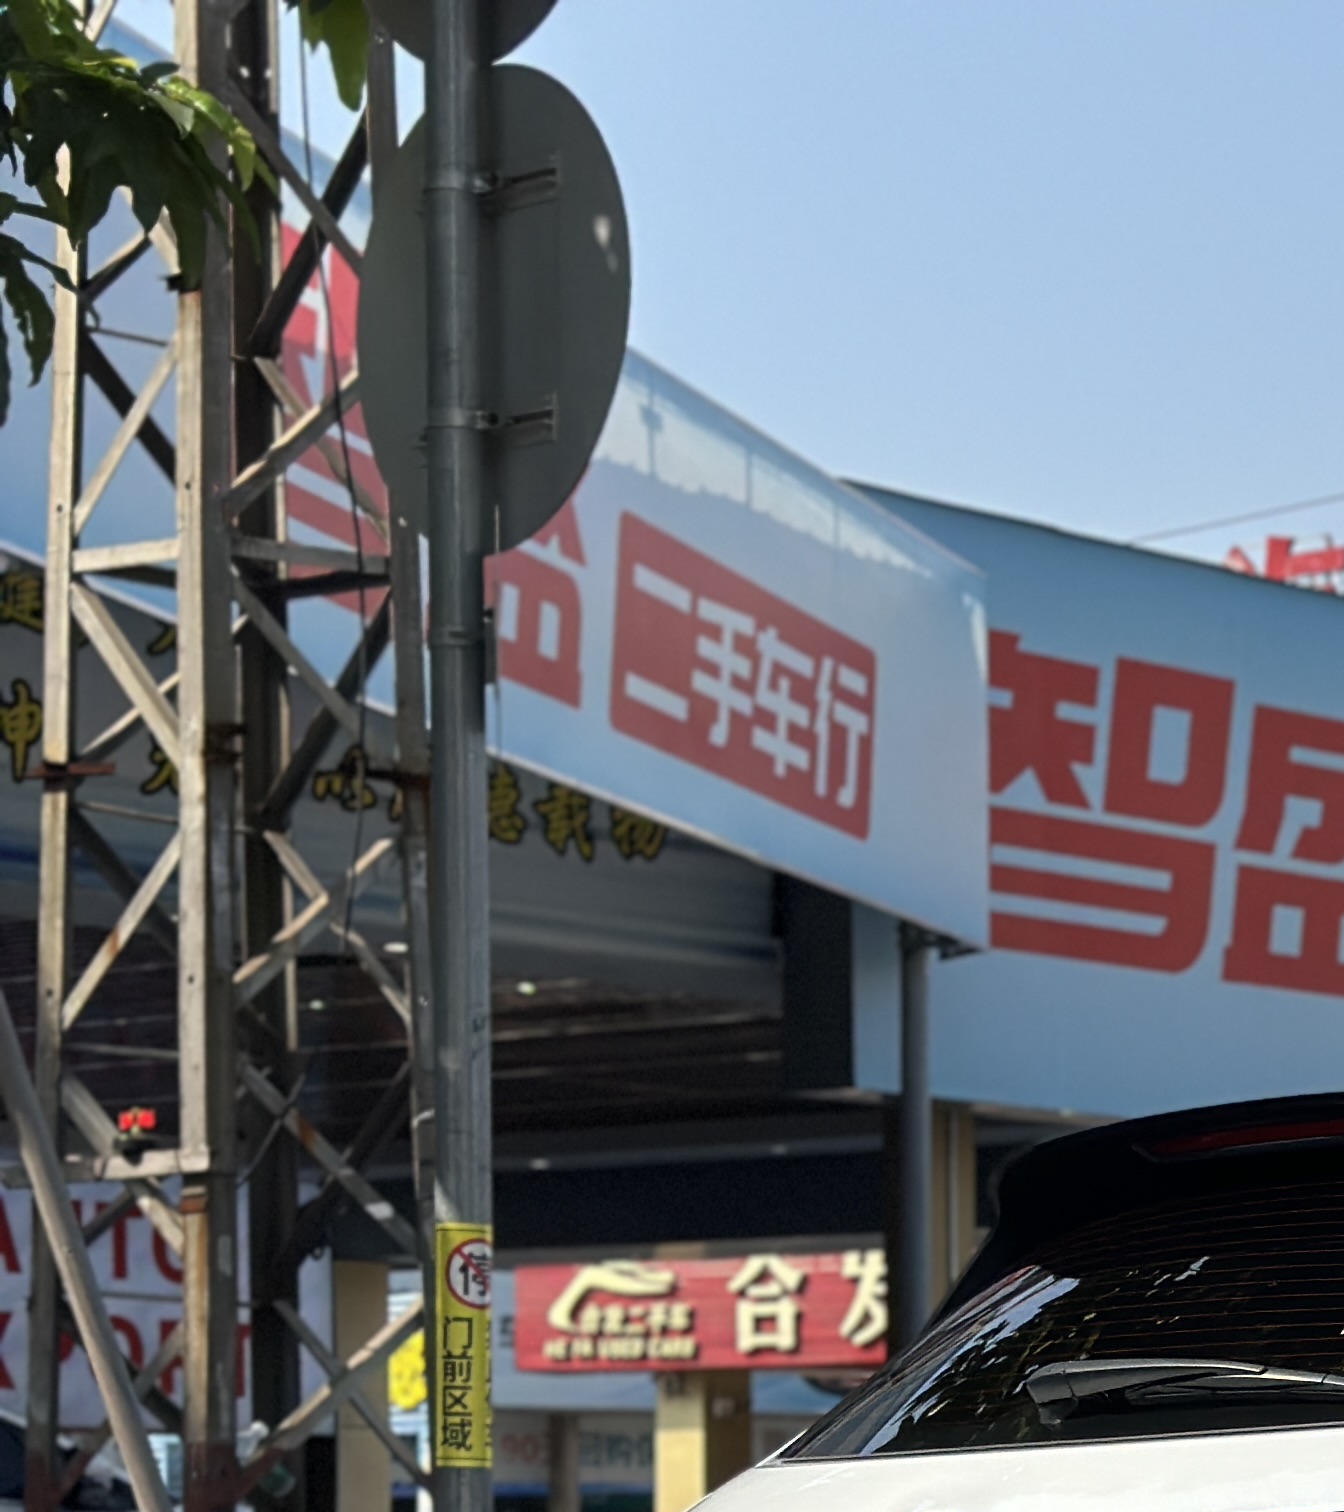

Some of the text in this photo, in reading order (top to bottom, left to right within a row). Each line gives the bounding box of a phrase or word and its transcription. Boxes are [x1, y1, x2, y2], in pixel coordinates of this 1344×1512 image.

[626, 563, 868, 809] 二手车行
[441, 1316, 473, 1451] 门前区域
